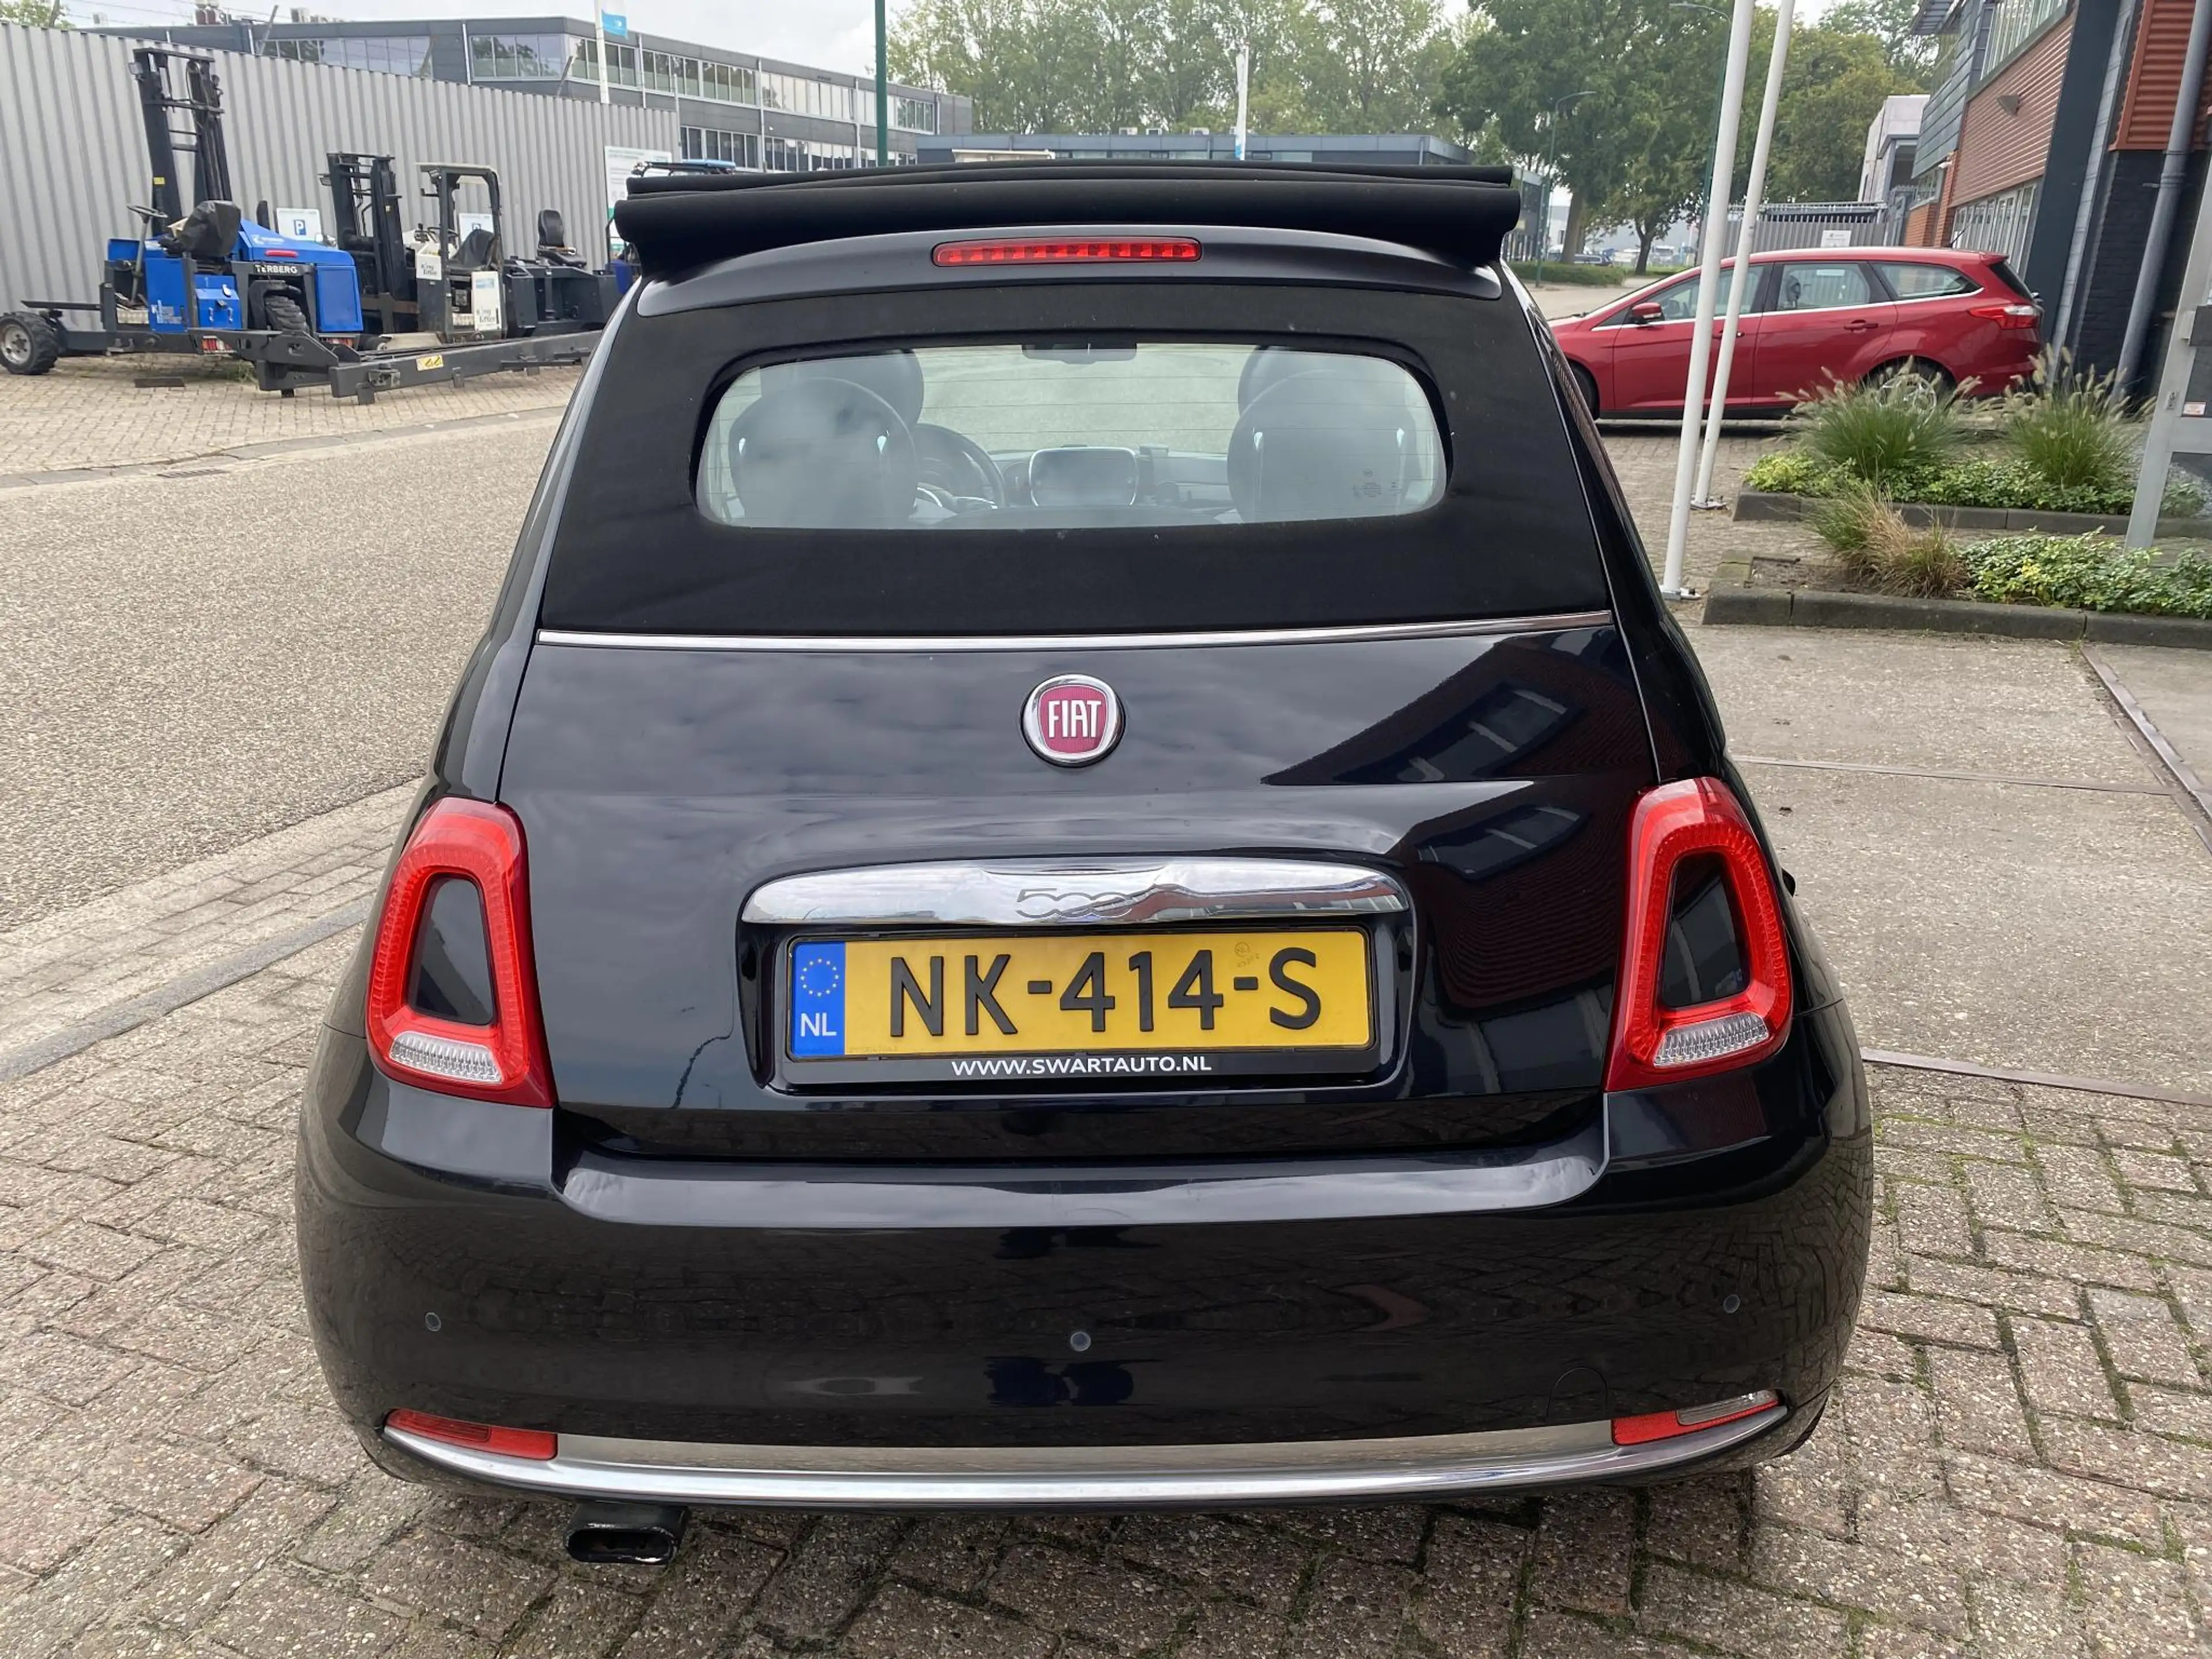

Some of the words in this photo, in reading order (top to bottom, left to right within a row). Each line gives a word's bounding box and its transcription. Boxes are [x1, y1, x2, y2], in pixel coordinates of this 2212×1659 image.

[254, 264, 298, 274] TERBERG
[1047, 700, 1102, 738] FIAT
[1016, 888, 1133, 919] 500
[890, 946, 1321, 1037] NK-414-S
[800, 1012, 837, 1037] NL
[951, 1056, 1212, 1076] WWW.SWARTAUTO.NL
